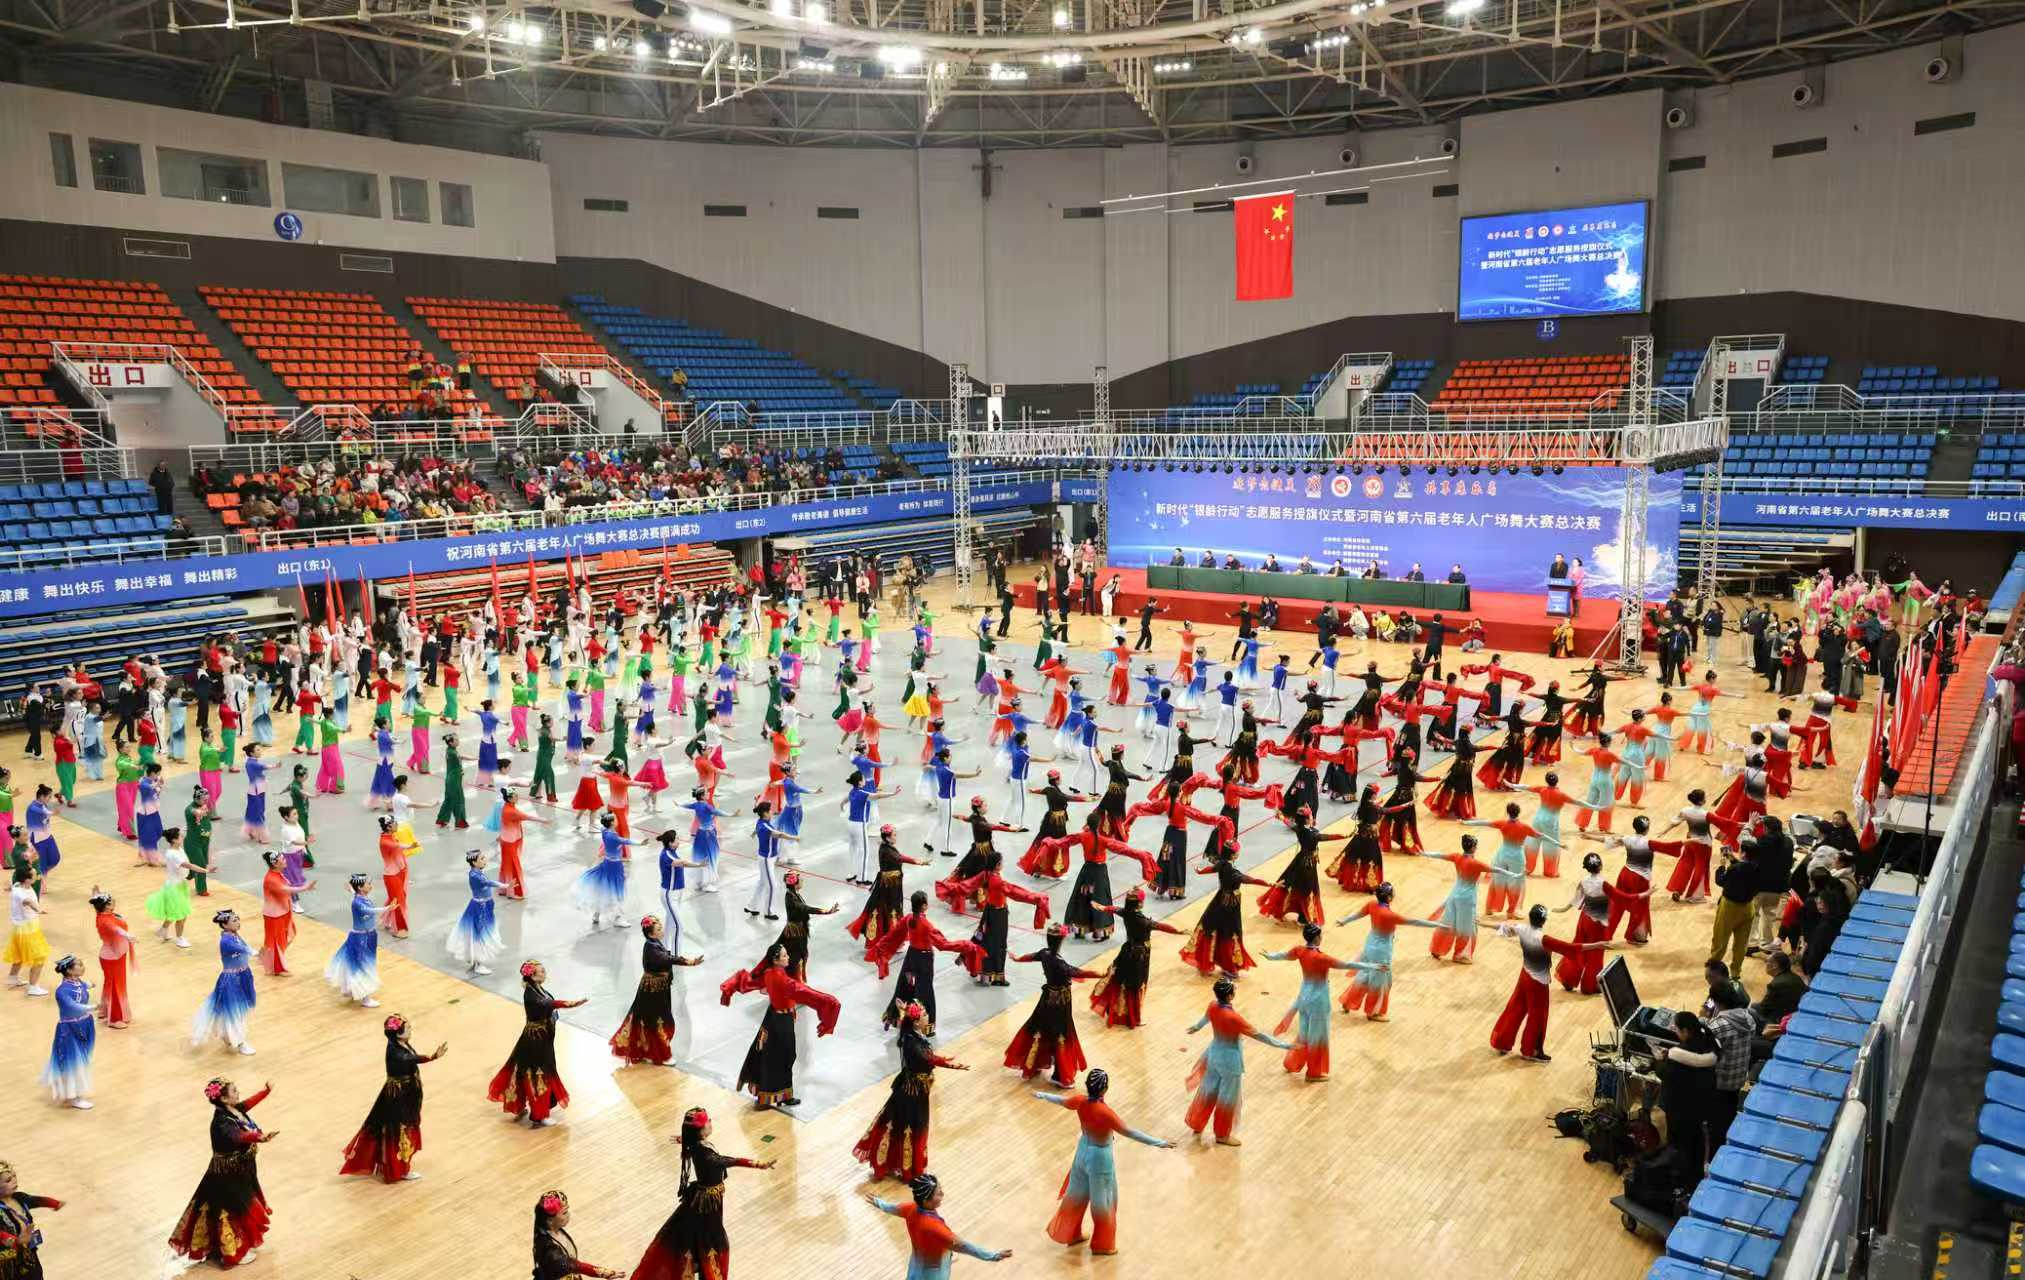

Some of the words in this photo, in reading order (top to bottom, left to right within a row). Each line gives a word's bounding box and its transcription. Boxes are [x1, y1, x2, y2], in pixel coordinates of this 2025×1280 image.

[1543, 320, 1554, 333] B
[89, 364, 145, 386] 出口
[1756, 504, 1950, 519] 河南省第六届老年人广场舞大赛总决赛
[446, 523, 700, 561] 祝河南省第六届老年人广场舞大赛总决赛圆满成功
[278, 558, 331, 575] 出口(东1)
[43, 580, 105, 598] 舞出快乐
[114, 573, 172, 591] 舞出幸福
[183, 567, 238, 585] 舞出精彩
